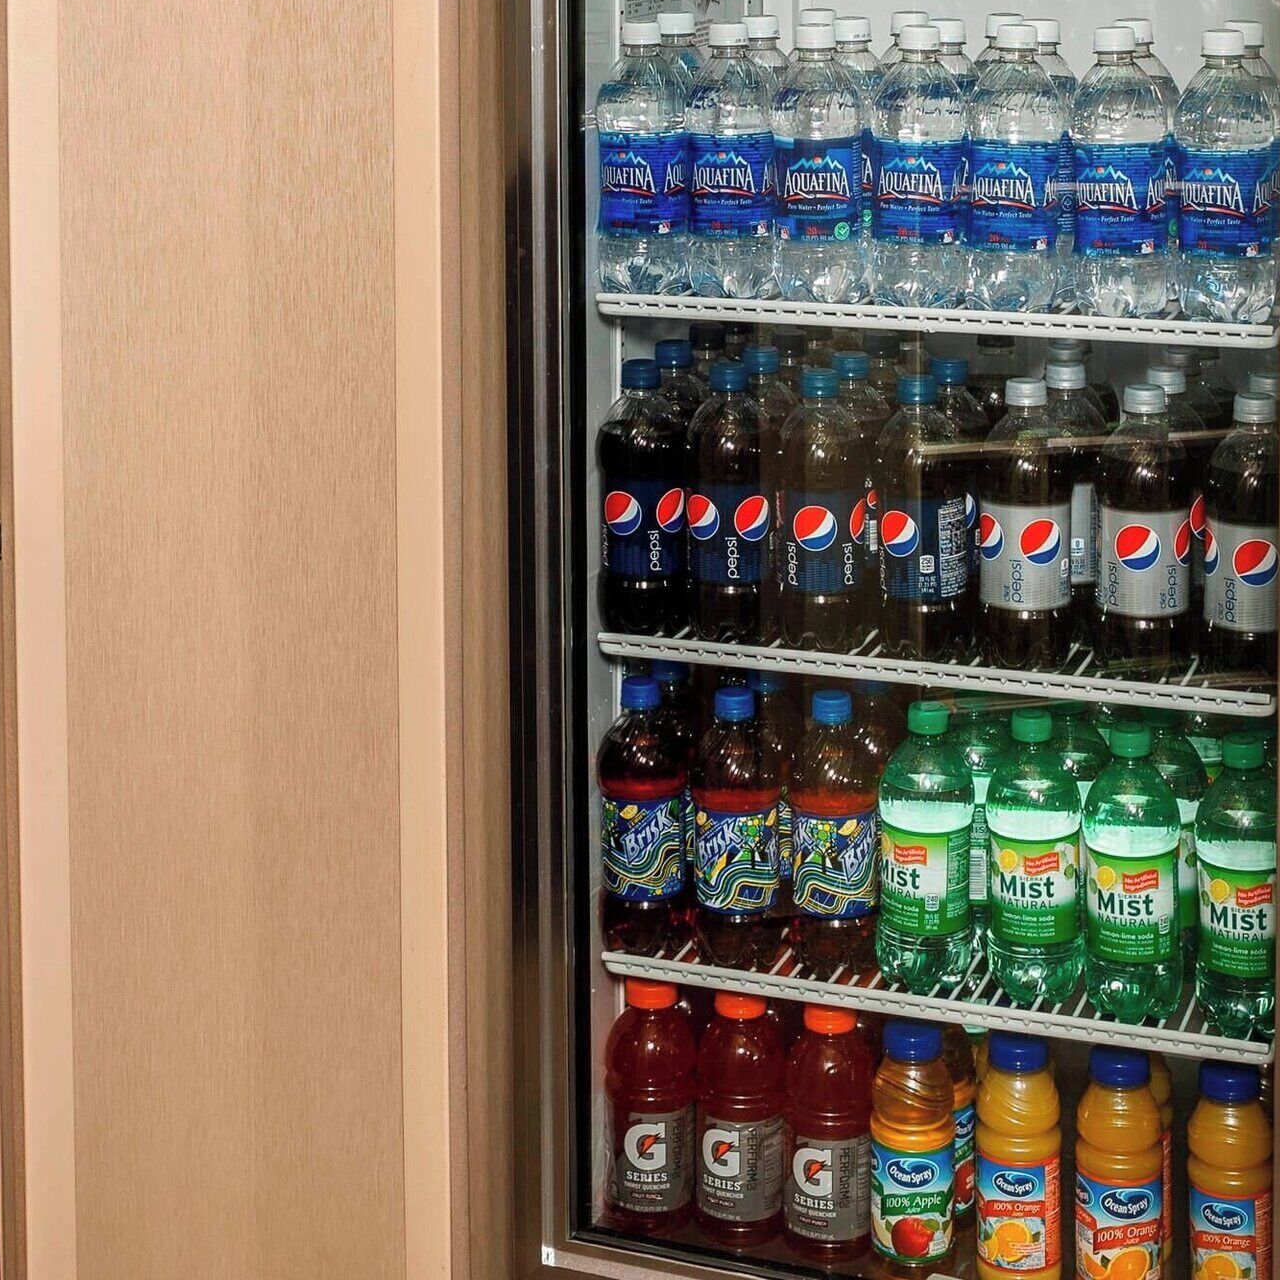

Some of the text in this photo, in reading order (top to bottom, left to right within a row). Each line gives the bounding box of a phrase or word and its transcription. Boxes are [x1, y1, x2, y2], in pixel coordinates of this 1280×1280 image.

[692, 163, 755, 193] AQUAFINA
[784, 168, 851, 199] AQUAFINA
[878, 167, 944, 201] AQUAFINA
[971, 173, 1037, 208] AQUAFINA
[649, 530, 662, 571] pepsi
[728, 536, 740, 579] pepsi
[788, 541, 797, 585] pepsi
[1000, 873, 1054, 898] Mist
[1000, 896, 1053, 909] NATURAL
[1097, 889, 1154, 916] Mist
[1210, 902, 1267, 930] Mist
[1098, 913, 1155, 927] NATURAL
[1210, 927, 1267, 942] NATURAL
[625, 1123, 667, 1170] G
[702, 1129, 741, 1177] G
[627, 1172, 668, 1182] SERIES
[703, 1174, 741, 1191] SERIES
[793, 1147, 833, 1196] G
[795, 1194, 833, 1210] SERIES
[886, 1194, 941, 1210] 100% Apple
[993, 1203, 1041, 1213] 100% Orange
[1098, 1225, 1157, 1242] 100% Orange
[1202, 1234, 1251, 1248] 100% Orange
